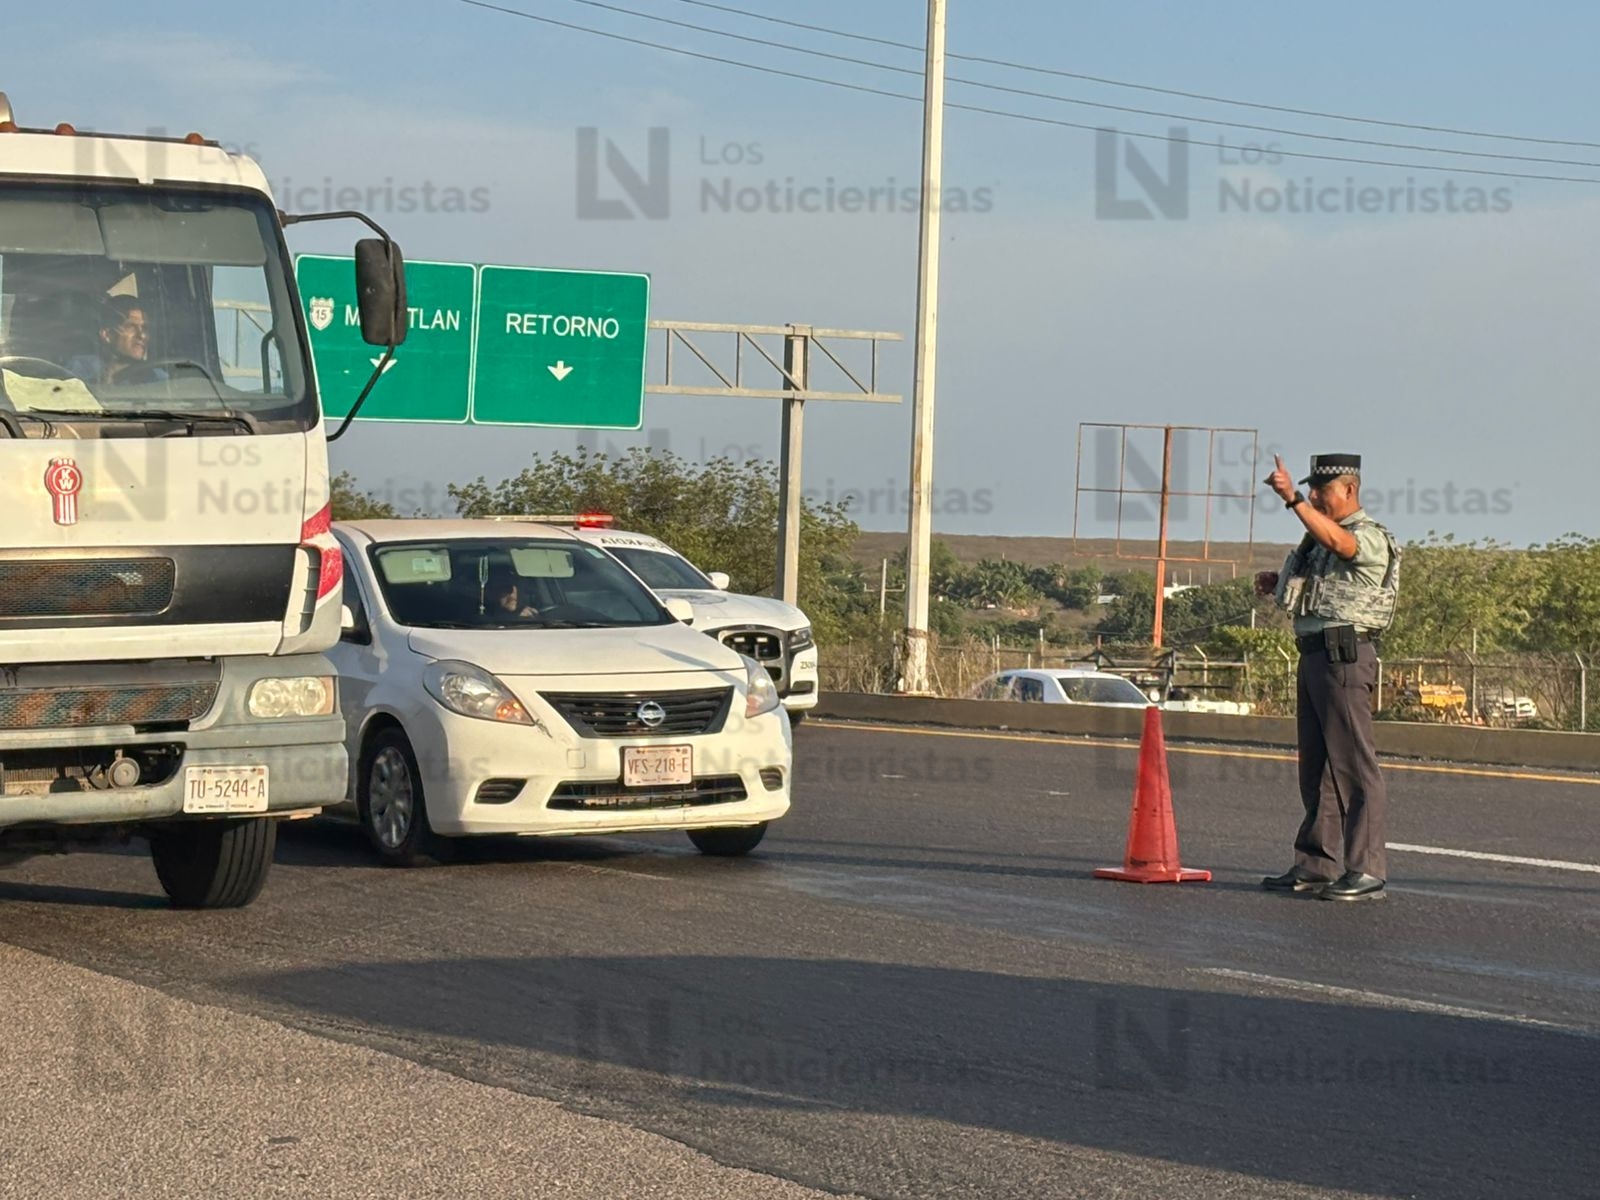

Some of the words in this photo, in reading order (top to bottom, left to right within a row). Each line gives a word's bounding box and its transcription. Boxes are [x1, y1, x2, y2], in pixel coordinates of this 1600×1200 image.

[315, 309, 327, 321] 15
[344, 304, 460, 331] MTLAN
[505, 312, 620, 340] RETORNO
[190, 778, 265, 800] TU-5244-A
